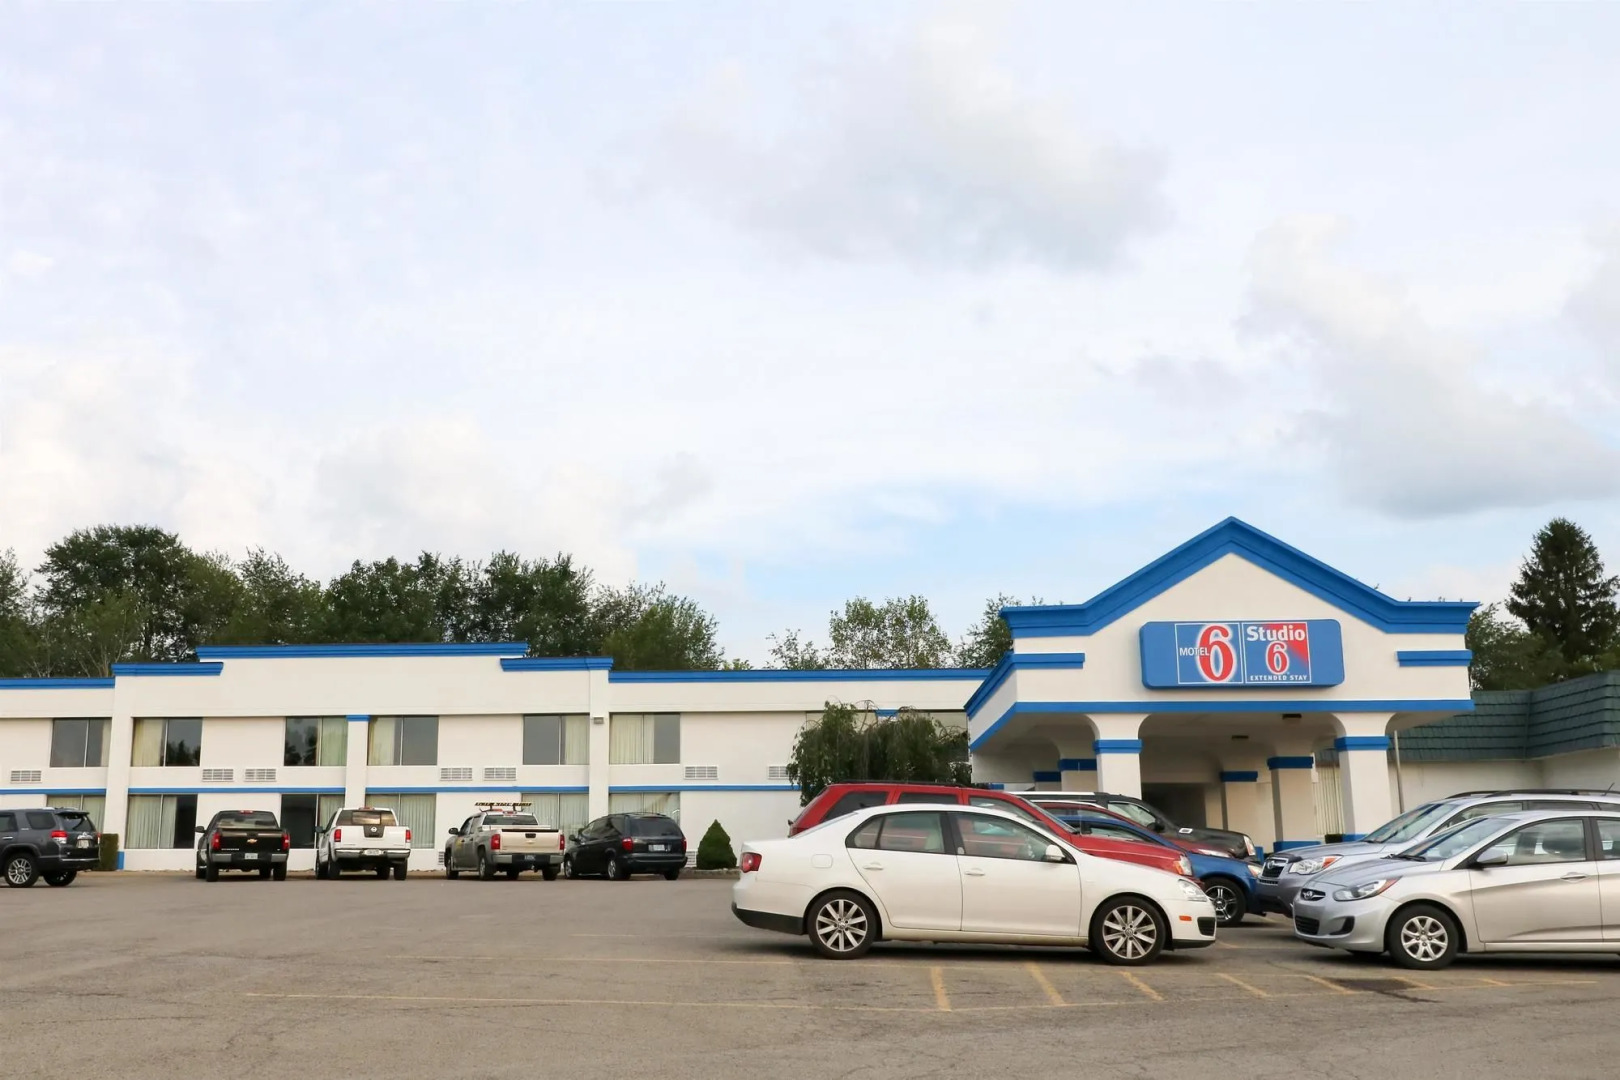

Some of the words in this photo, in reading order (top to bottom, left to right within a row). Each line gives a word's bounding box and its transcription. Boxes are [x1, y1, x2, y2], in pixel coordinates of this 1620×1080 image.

[1246, 624, 1306, 642] Studio
[1179, 647, 1210, 657] MOTEL
[1197, 624, 1236, 682] 6
[1266, 641, 1289, 675] 6
